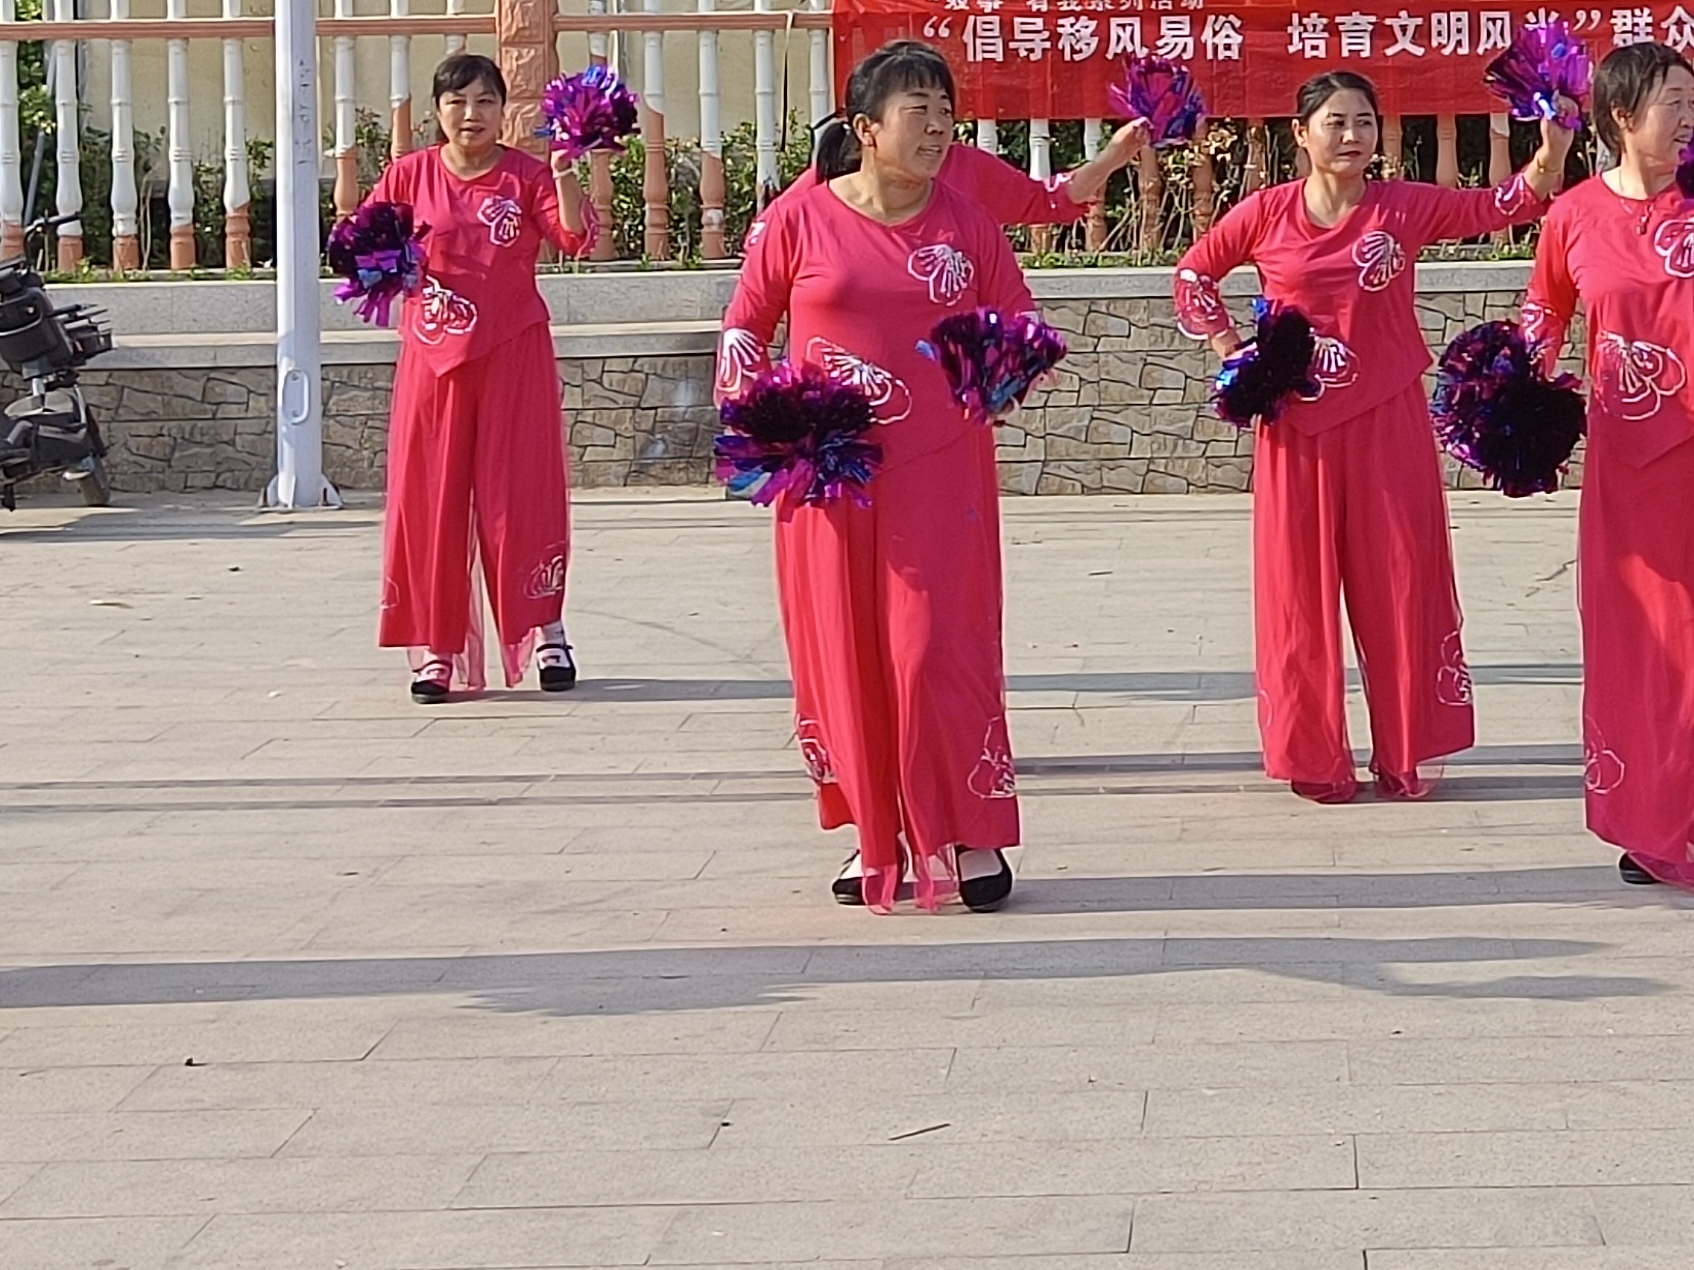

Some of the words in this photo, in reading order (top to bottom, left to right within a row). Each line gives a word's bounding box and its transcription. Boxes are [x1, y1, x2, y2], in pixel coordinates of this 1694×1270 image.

[922, 13, 1245, 62] “倡导移风易俗
